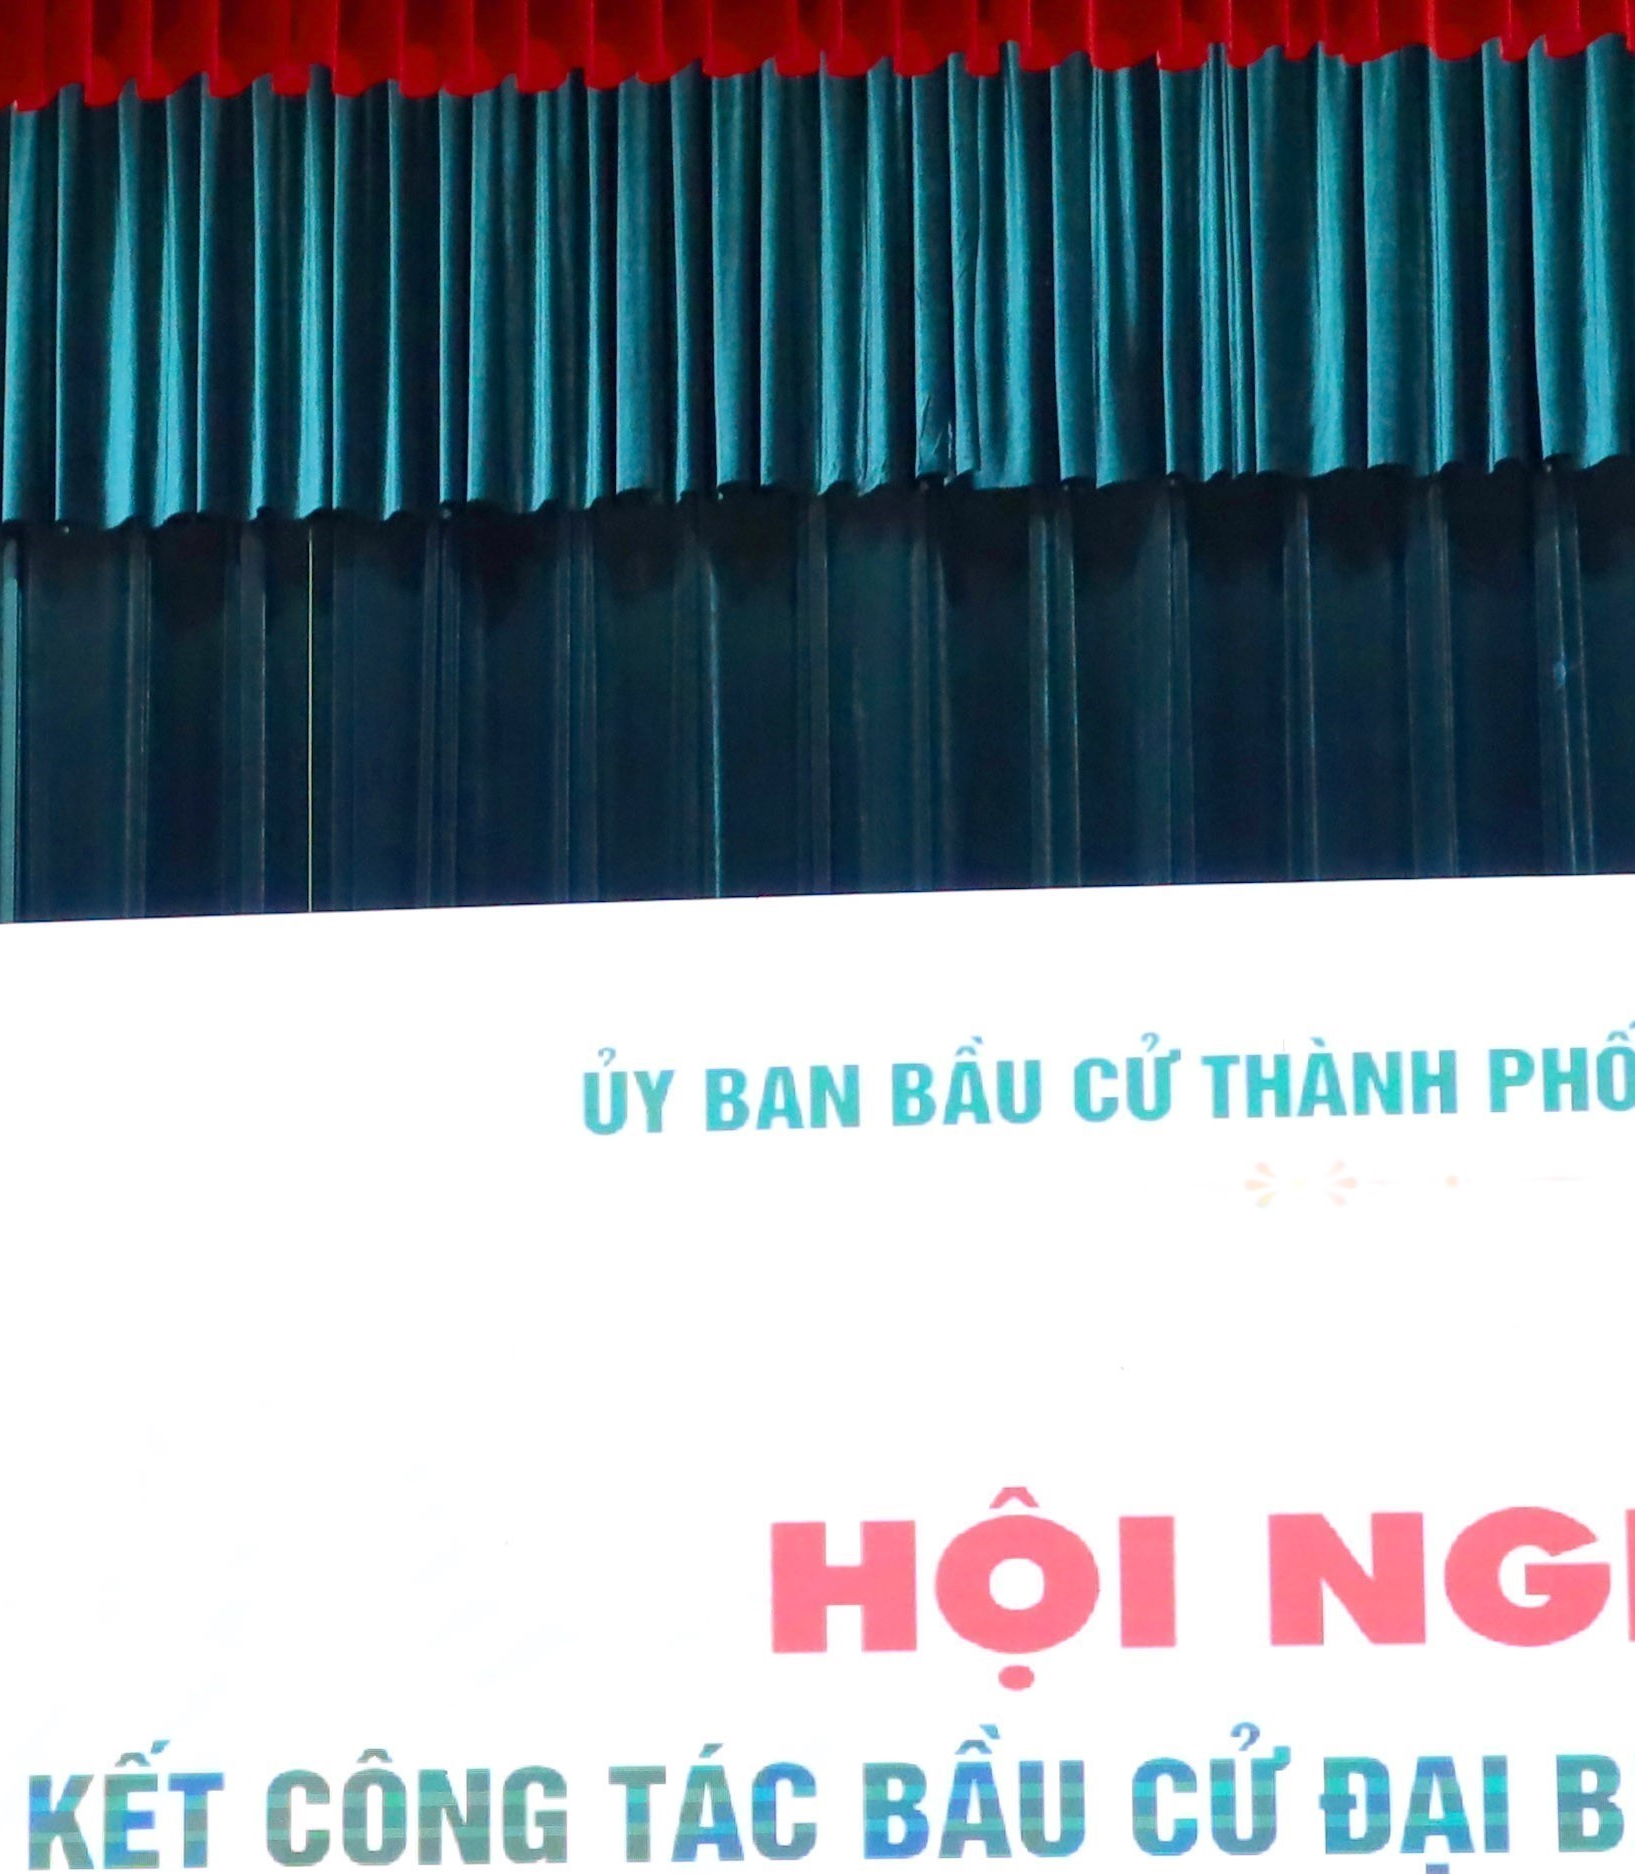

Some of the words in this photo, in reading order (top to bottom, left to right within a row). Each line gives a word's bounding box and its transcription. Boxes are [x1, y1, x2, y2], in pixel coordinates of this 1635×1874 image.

[583, 1048, 674, 1135] ỦY
[705, 1065, 860, 1131] BAN
[892, 1046, 1042, 1126] BẦU
[1074, 1033, 1181, 1122] CỬ
[1201, 1037, 1457, 1118] THÀNH
[771, 1487, 1176, 1691] HỘI
[29, 1740, 224, 1869] KẾT
[266, 1749, 567, 1867] CÔNG
[609, 1743, 817, 1862] TÁC
[863, 1724, 1085, 1859] BẦU
[1132, 1722, 1291, 1856] CỬ
